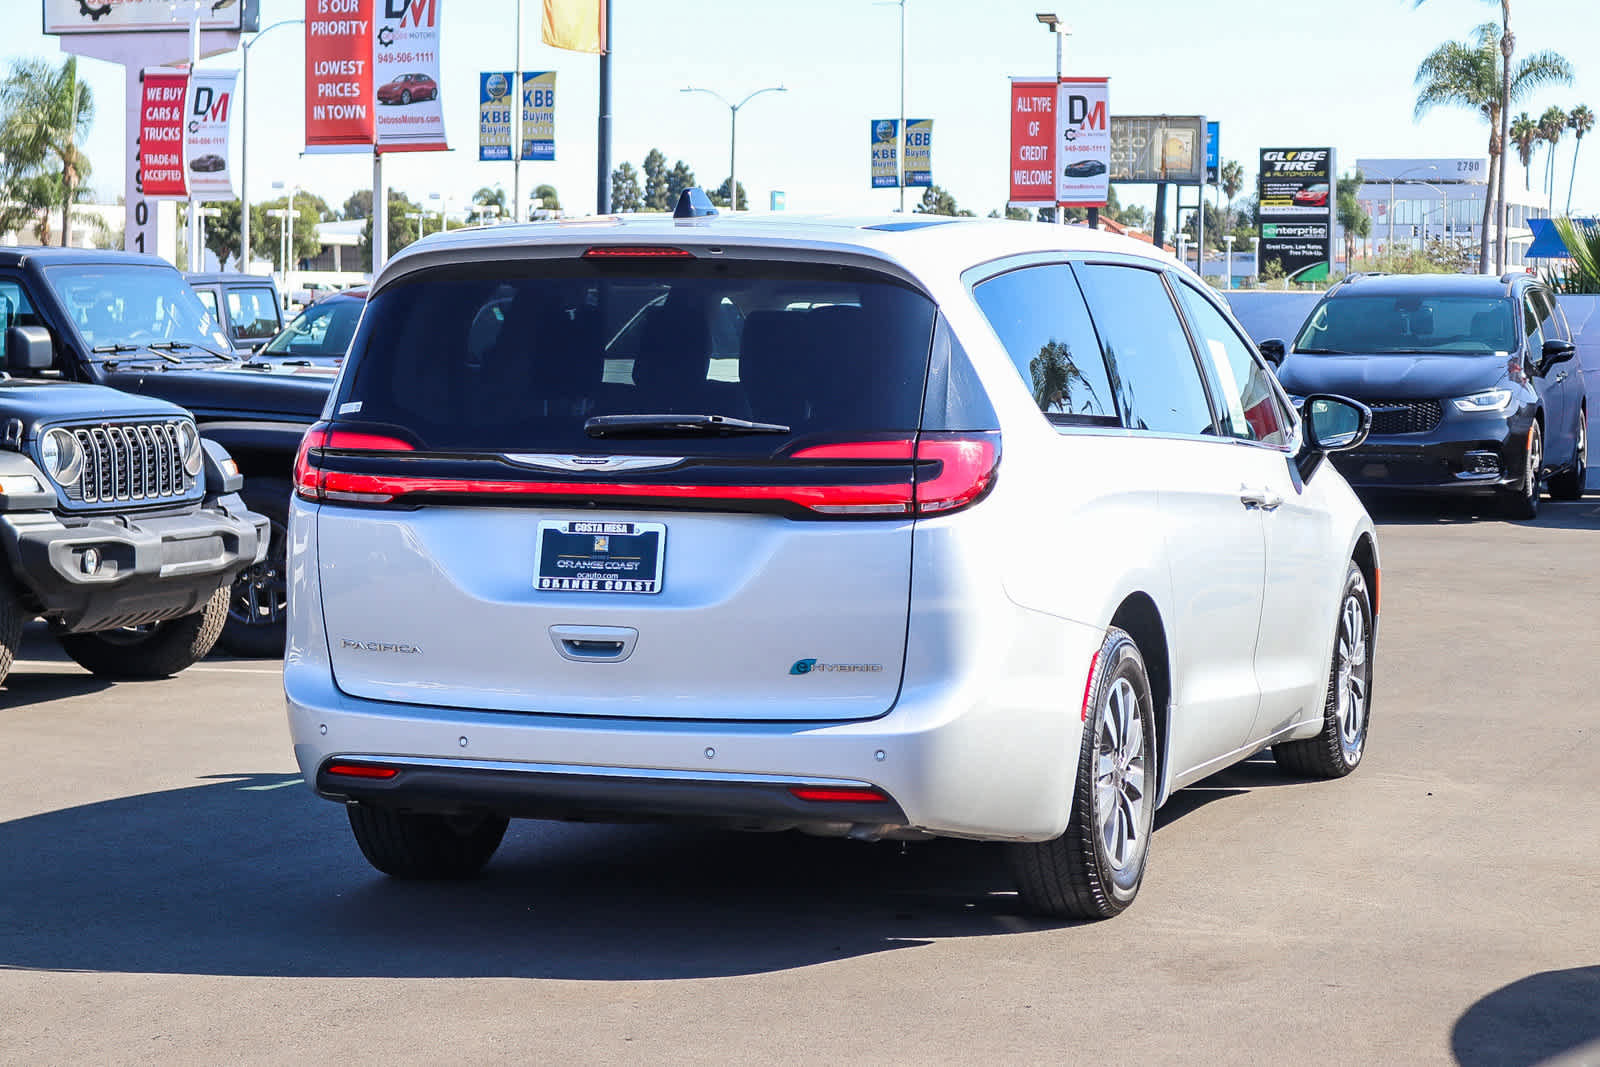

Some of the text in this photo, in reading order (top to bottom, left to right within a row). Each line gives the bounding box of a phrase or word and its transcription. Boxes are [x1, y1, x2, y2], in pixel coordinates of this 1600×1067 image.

[318, 0, 359, 14] IS OUR
[311, 20, 368, 36] PRIORITY
[377, 52, 434, 63] 949-506-1111
[314, 60, 365, 76] LOWEST
[146, 87, 184, 101] WE BUY
[318, 82, 361, 98] PRICES
[523, 89, 554, 108] KBB
[1017, 96, 1052, 112] ALL TYPE
[145, 107, 180, 121] CARS &
[313, 104, 367, 120] IN TOWN
[481, 110, 511, 123] KBB
[523, 110, 554, 124] Buying
[1069, 95, 1106, 130] DM
[143, 126, 181, 141] TRUCKS
[1028, 121, 1040, 136] OF
[905, 132, 930, 146] KBB
[143, 154, 179, 165] TRADE-IN
[872, 149, 897, 159] KBB
[1020, 145, 1048, 161] CREDIT
[1263, 151, 1327, 161] GLOBE
[1273, 161, 1318, 171] TIRE
[1457, 161, 1480, 171] 2790
[144, 169, 182, 181] ACCEPTED
[1014, 169, 1053, 185] WELCOME
[1265, 225, 1326, 236] enterprise
[574, 522, 628, 533] COSTA MESA
[556, 559, 641, 570] ORANGE COAST
[576, 571, 619, 579] ocauto.com
[542, 578, 653, 592] ORANGE COAST
[340, 638, 424, 655] PACIFICA
